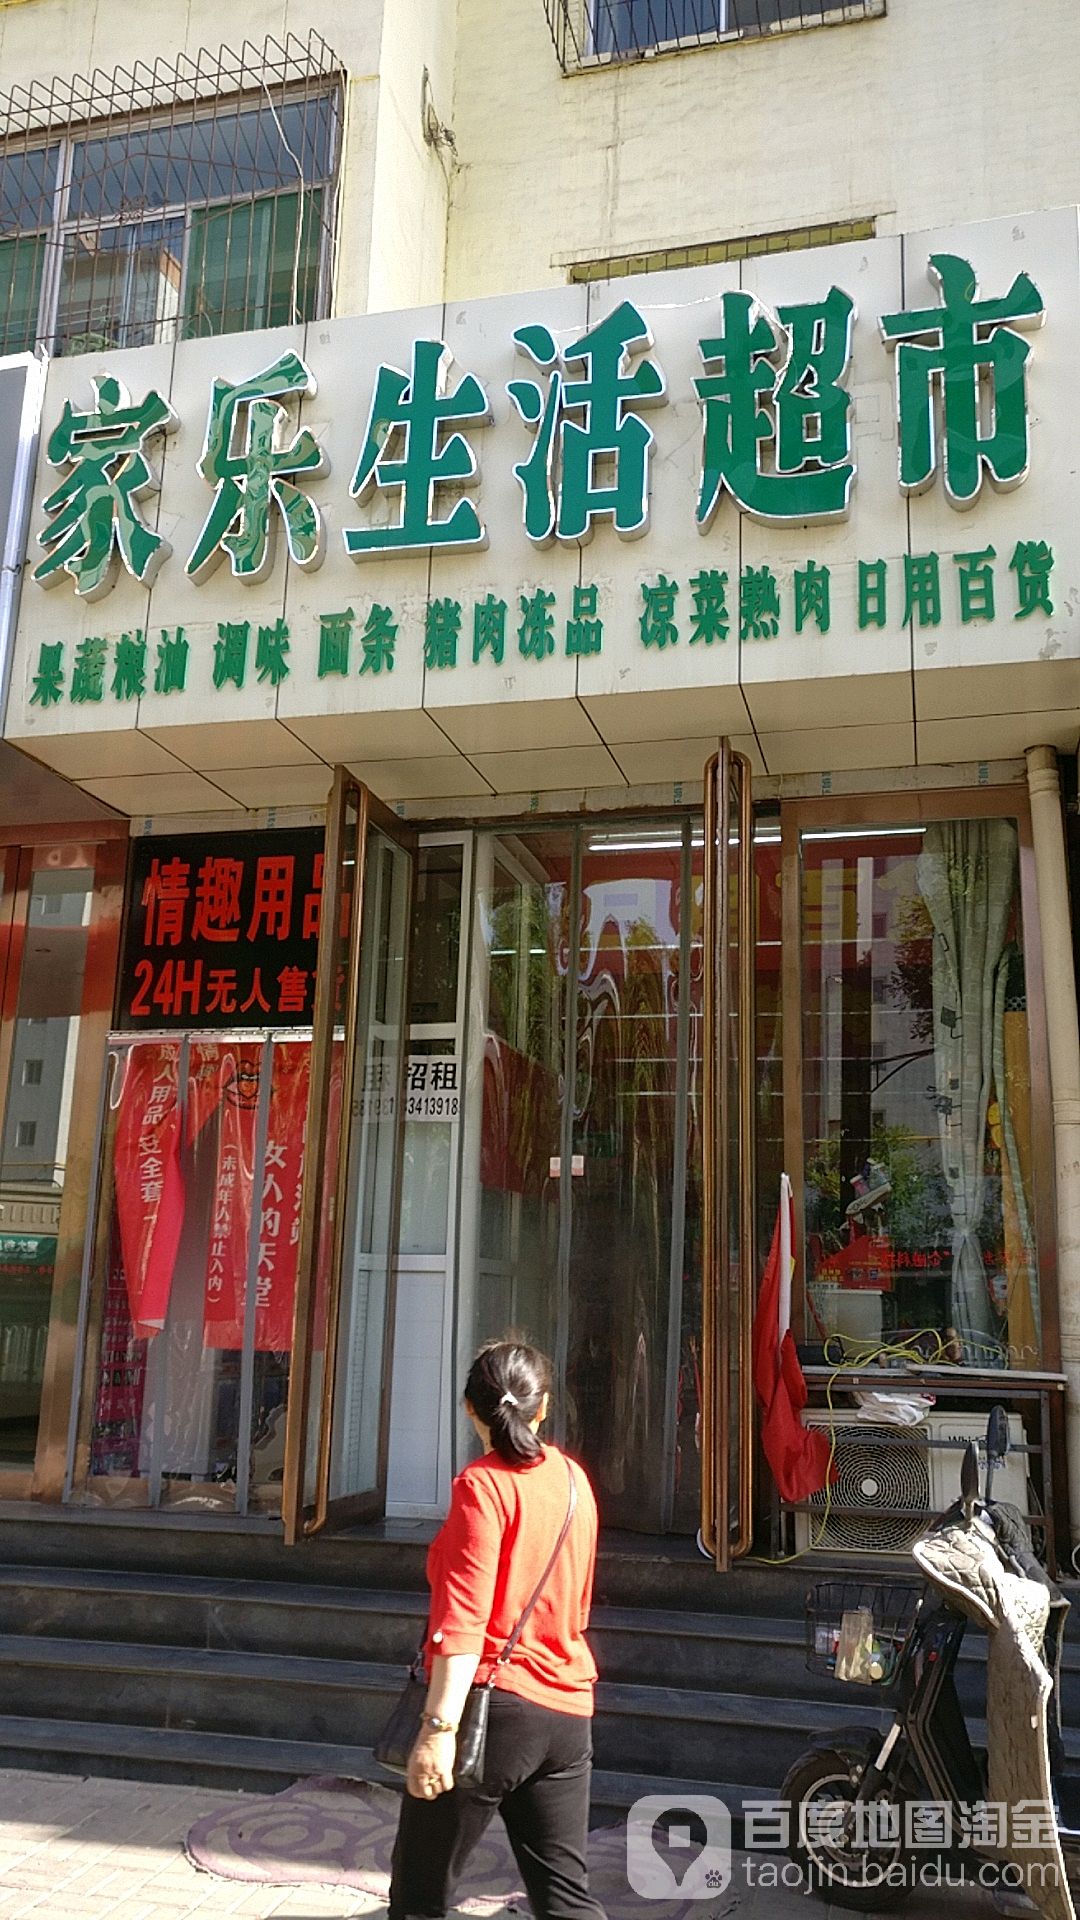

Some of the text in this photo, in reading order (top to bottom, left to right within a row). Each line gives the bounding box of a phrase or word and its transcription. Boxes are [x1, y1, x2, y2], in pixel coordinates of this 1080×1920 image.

[31, 252, 1046, 600] 家乐生活超市
[212, 617, 290, 691] 调味
[317, 603, 399, 679] 面条
[423, 583, 604, 670] 猪肉冻品
[638, 559, 831, 651] 凉菜熟肉
[857, 539, 1055, 630] 日用百货
